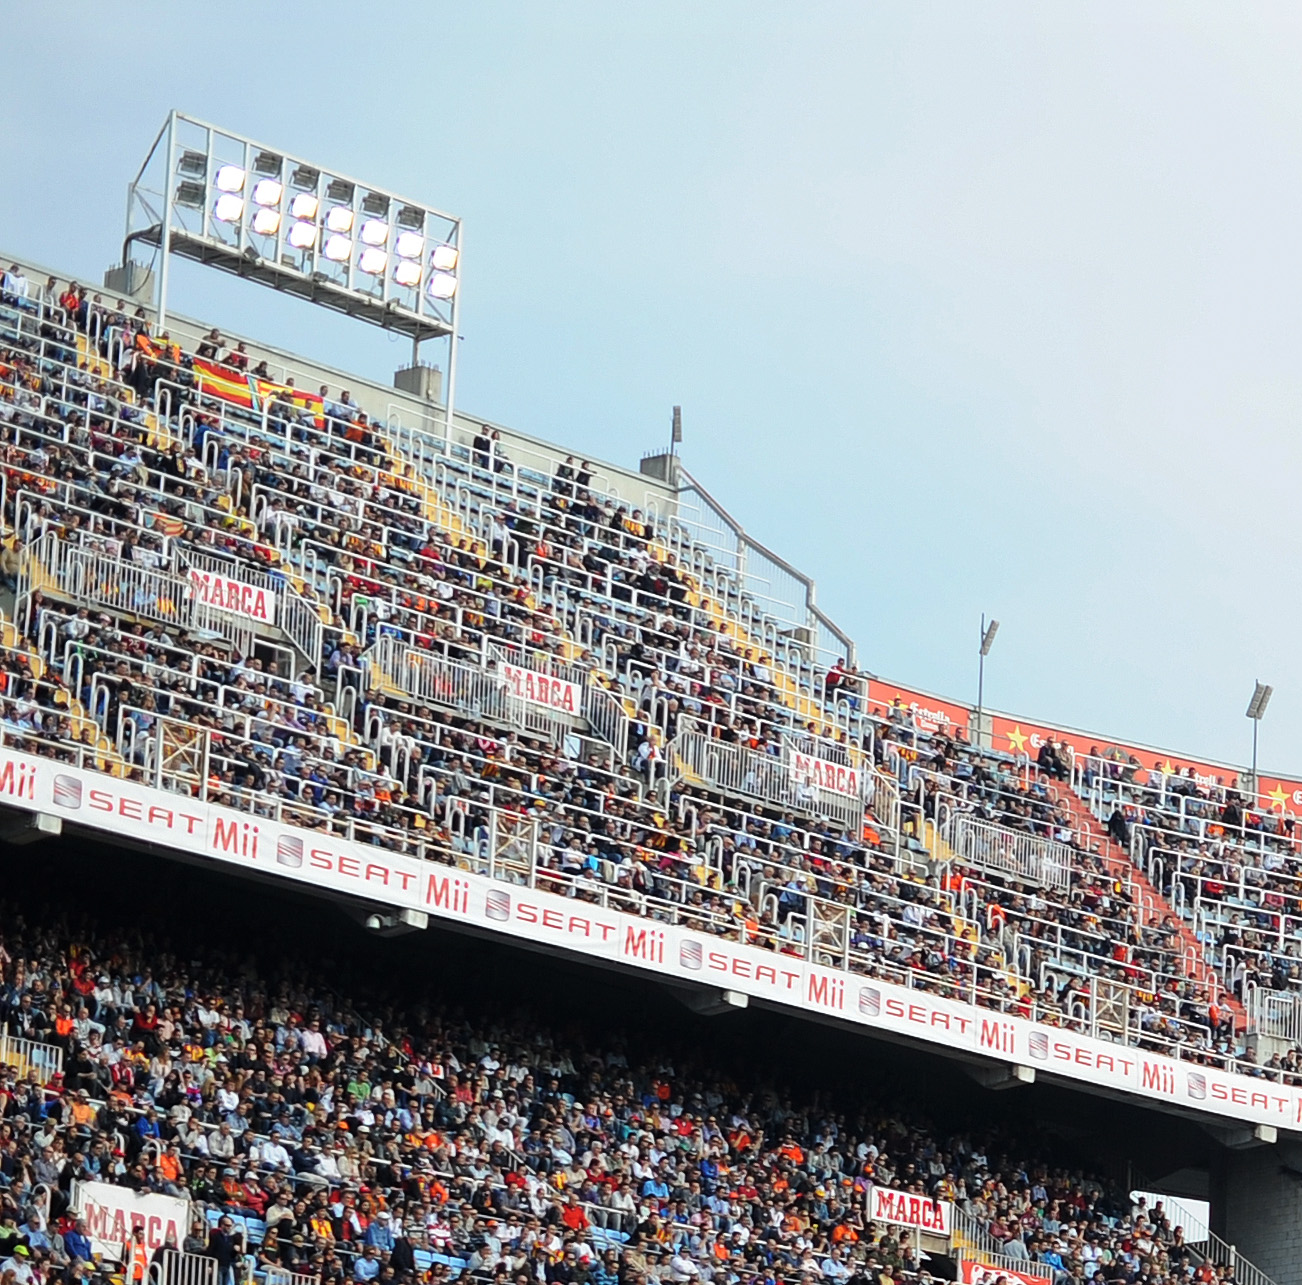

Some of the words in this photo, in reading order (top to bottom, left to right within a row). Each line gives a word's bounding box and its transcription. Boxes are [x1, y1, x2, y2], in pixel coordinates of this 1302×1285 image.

[89, 790, 204, 835] SEAT
[213, 822, 259, 860] Mii
[311, 849, 416, 893] SEAT
[427, 874, 469, 914] Mii
[517, 904, 616, 942] SEAT
[625, 925, 665, 963] Mii
[709, 951, 800, 988] SEAT
[809, 974, 844, 1011] Mii
[886, 998, 973, 1034] SEAT
[981, 1018, 1015, 1054] Mii
[1054, 1043, 1134, 1075] SEAT
[1142, 1061, 1174, 1095] Mii
[1211, 1083, 1290, 1113] SEAT
[877, 1191, 944, 1230] MARCA
